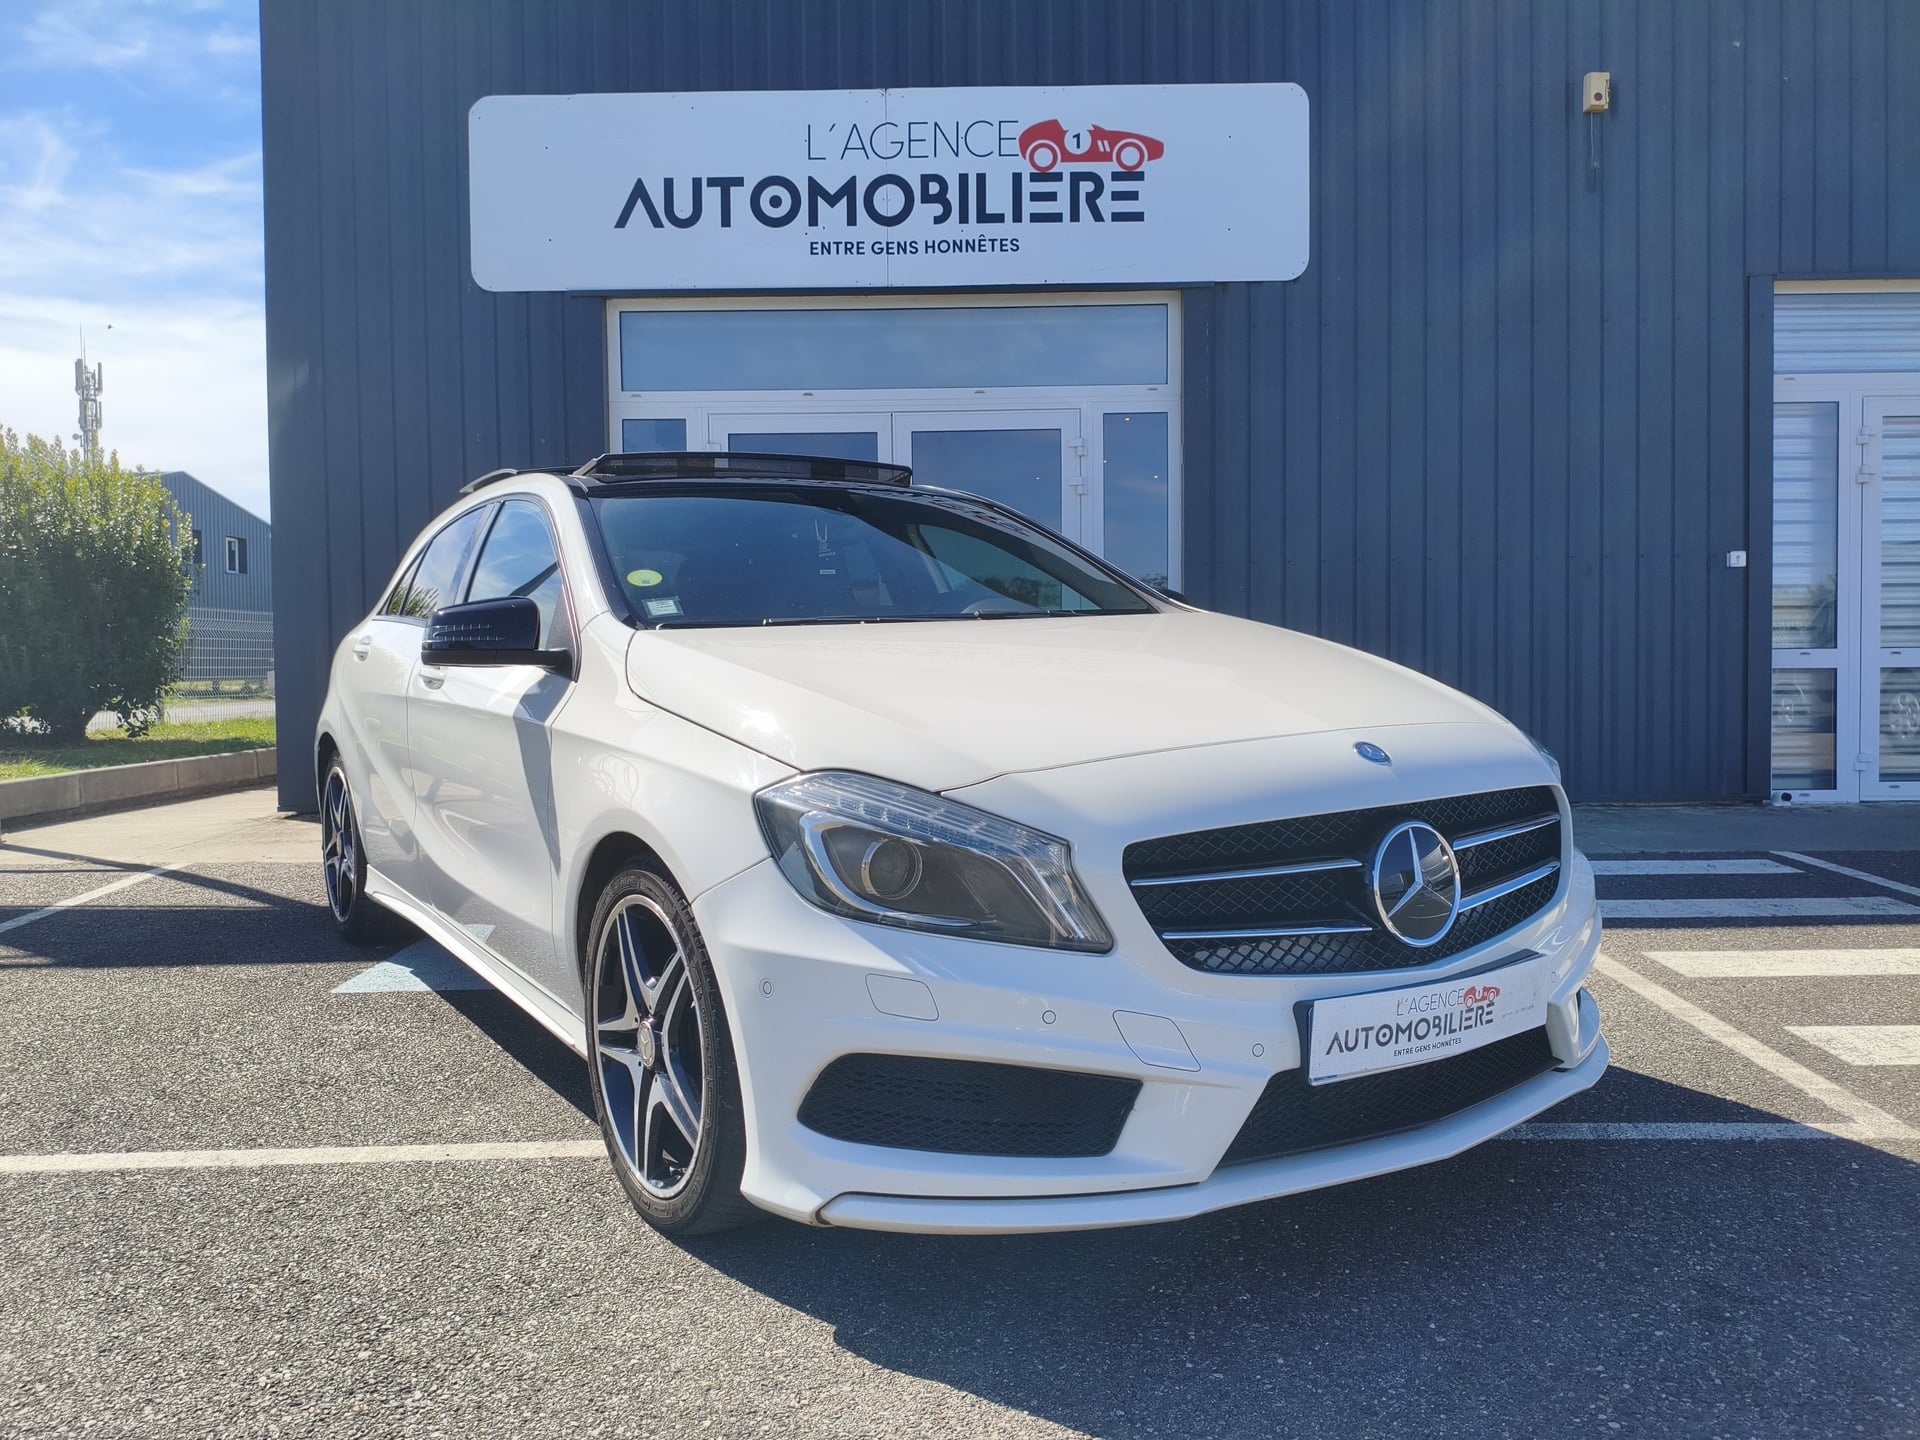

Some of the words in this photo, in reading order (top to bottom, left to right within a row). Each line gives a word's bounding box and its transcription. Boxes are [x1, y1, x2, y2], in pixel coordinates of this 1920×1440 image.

[807, 119, 1020, 161] L'AGENCE
[1071, 131, 1082, 149] 1
[614, 171, 1145, 229] AUTOMOBILIERE
[809, 240, 866, 256] ENTRE
[871, 239, 919, 255] GENS
[924, 234, 1020, 254] HONNÊTES
[1325, 1002, 1496, 1055] AUTOMOBILIERE
[1393, 1047, 1414, 1057] ENTRE
[1414, 1043, 1431, 1053] GENS
[1431, 1037, 1462, 1049] HONNÊTES
